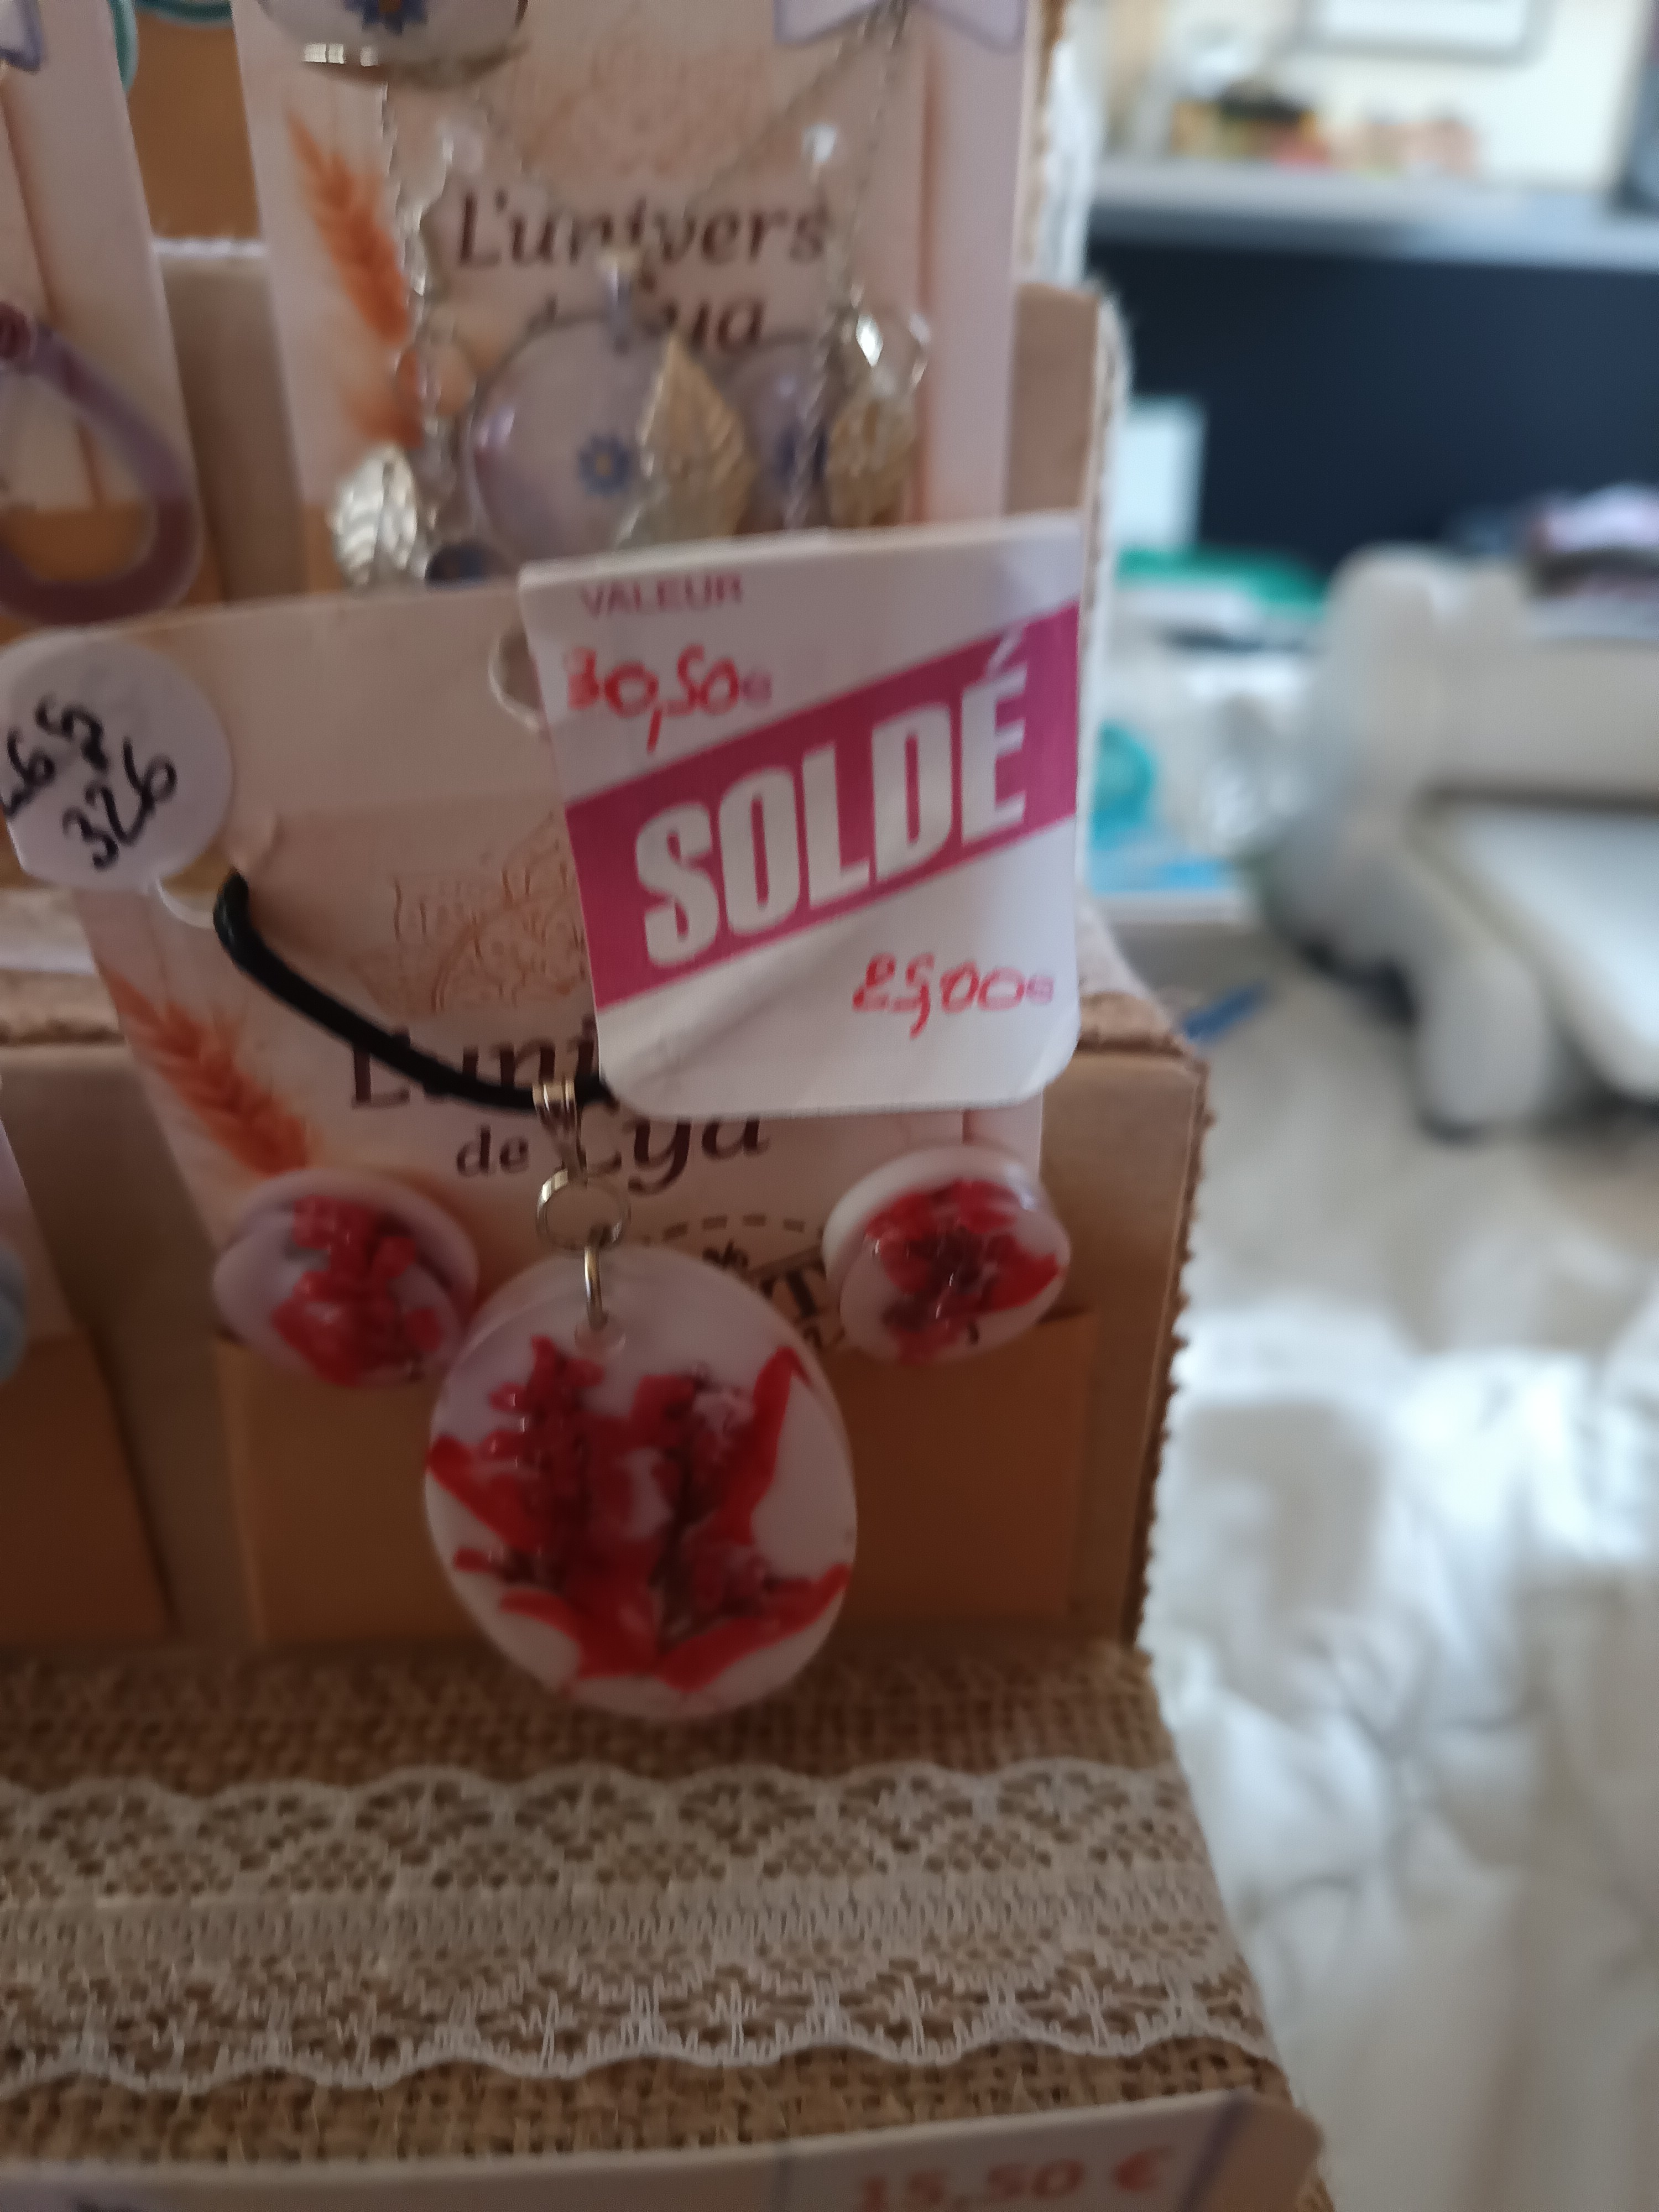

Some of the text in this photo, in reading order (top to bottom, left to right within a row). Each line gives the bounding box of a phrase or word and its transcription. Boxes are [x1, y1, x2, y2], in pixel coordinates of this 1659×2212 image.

[582, 572, 742, 617] VALEUR
[62, 738, 178, 871] 326
[633, 622, 1027, 971] SOLDÉ
[456, 1124, 529, 1177] de
